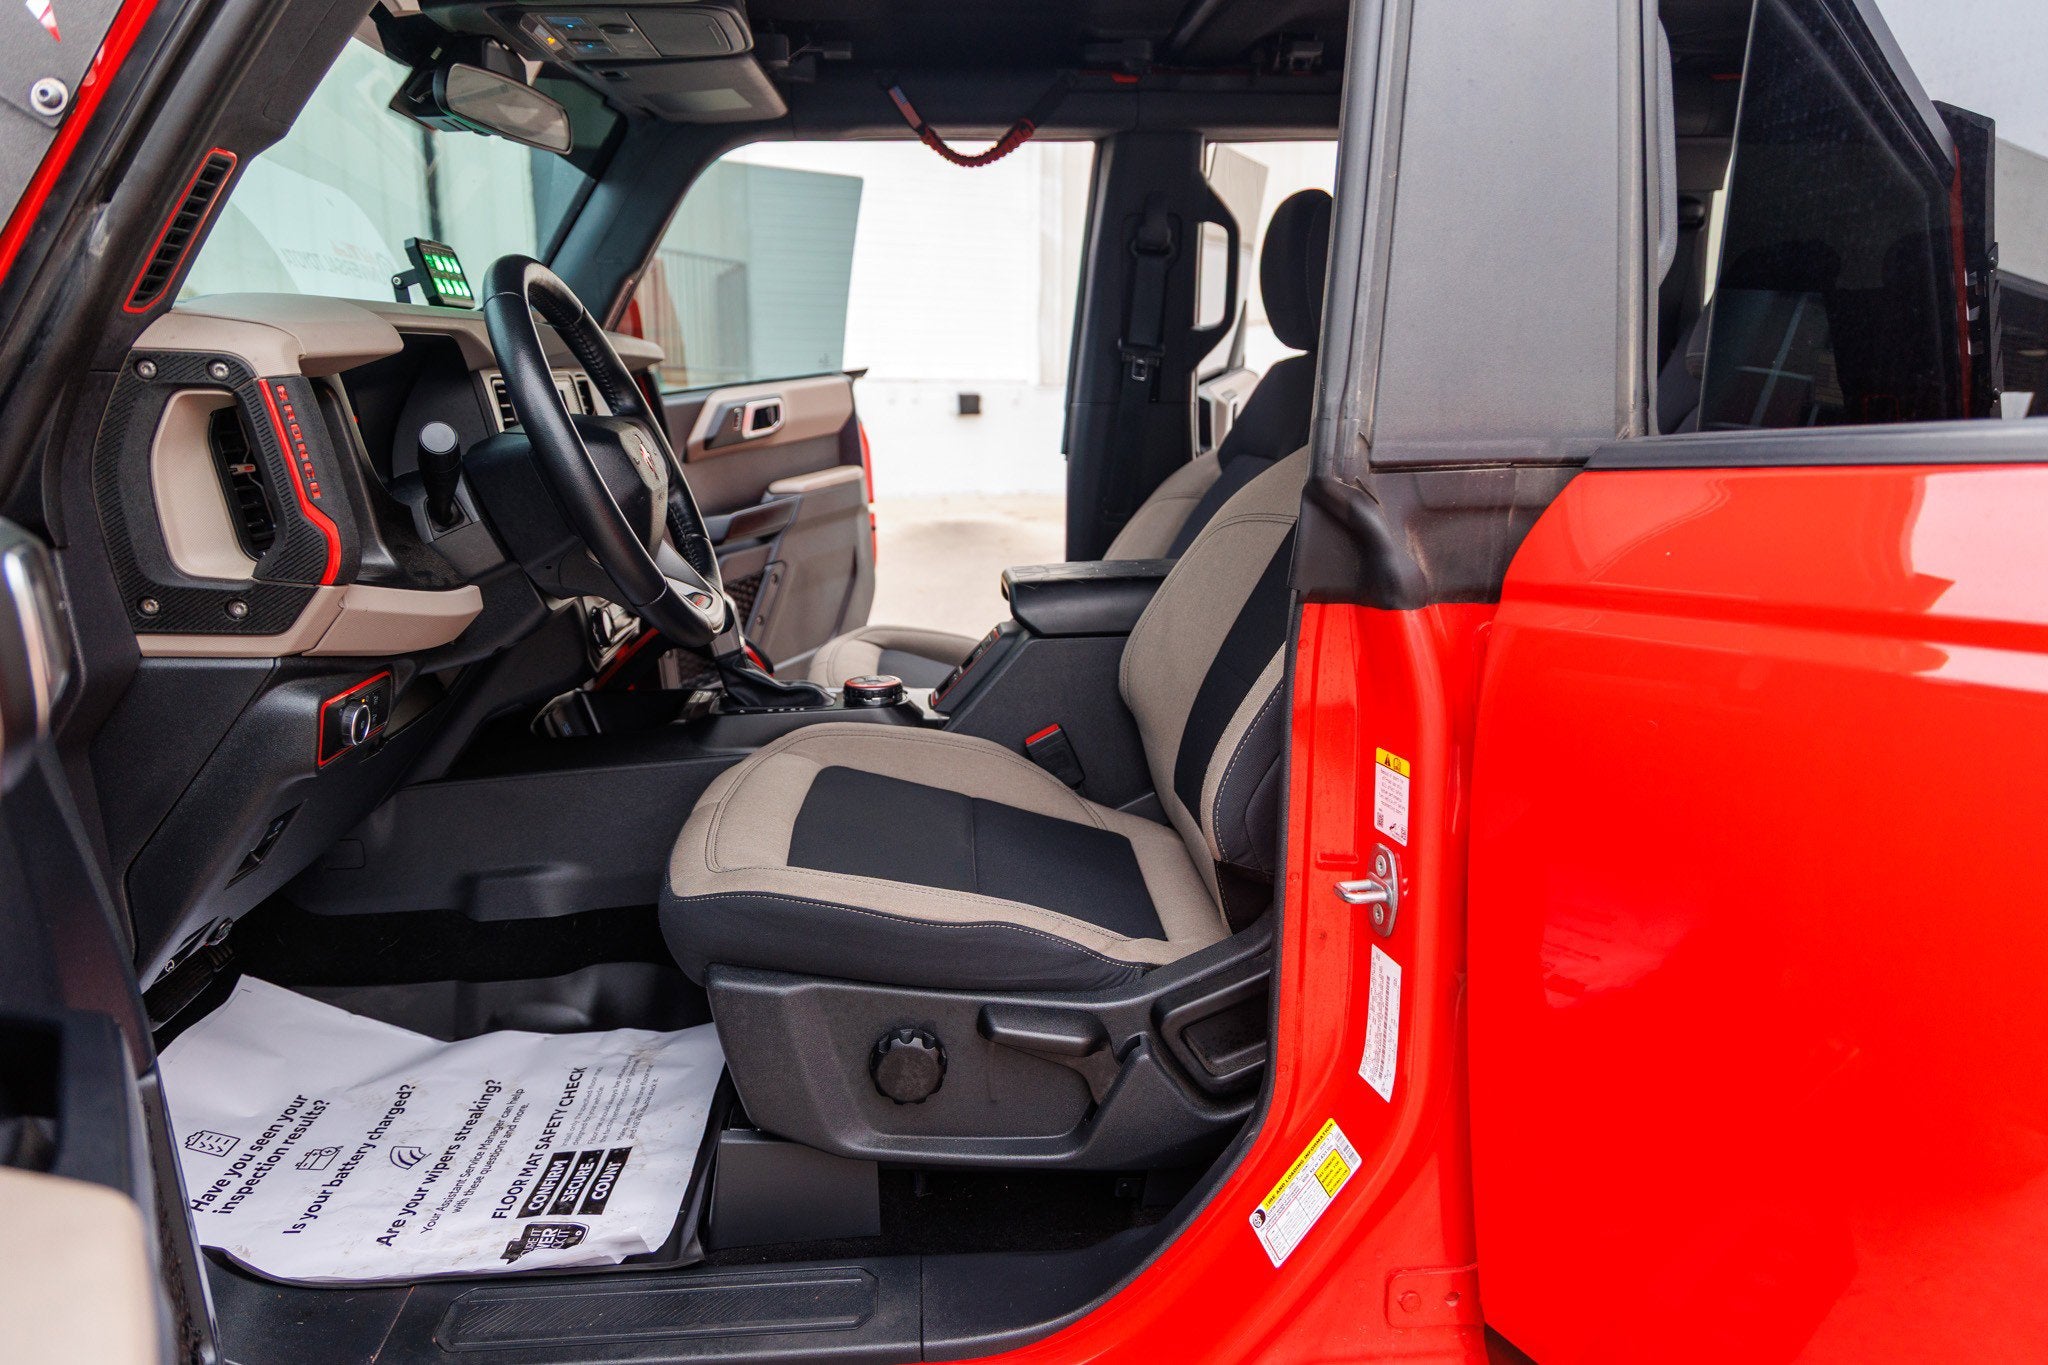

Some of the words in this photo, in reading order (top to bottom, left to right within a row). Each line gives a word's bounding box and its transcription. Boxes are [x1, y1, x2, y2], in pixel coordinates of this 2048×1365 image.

[275, 384, 322, 499] BRONCO
[501, 1104, 514, 1119] can
[507, 1088, 525, 1106] help
[191, 1178, 231, 1213] Have
[223, 1153, 256, 1178] you
[249, 1124, 284, 1152] seen
[276, 1094, 309, 1122] your
[478, 1117, 506, 1152] Manager
[491, 1179, 529, 1219] FLOOR
[518, 1152, 544, 1177] MAT
[535, 1109, 568, 1150] SAFETY
[559, 1066, 588, 1107] CHECK
[1303, 1123, 1333, 1160] INFORMATION
[212, 1146, 290, 1214] inspection
[282, 1099, 331, 1145] results?
[282, 1222, 307, 1235] Is
[299, 1190, 333, 1220] your
[322, 1142, 377, 1187] battery
[366, 1084, 416, 1140] charged?
[376, 1219, 406, 1247] Are
[398, 1187, 430, 1216] your
[422, 1144, 461, 1186] wipers
[454, 1079, 502, 1142] streaking?
[452, 1200, 468, 1214] with
[463, 1176, 485, 1198] these
[480, 1139, 508, 1176] questions
[503, 1124, 517, 1139] and
[512, 1103, 530, 1124] more.
[459, 1151, 485, 1178] Service
[436, 1177, 468, 1212] Assistant
[527, 1159, 569, 1211] CONFIRM
[560, 1162, 595, 1202] SECURE
[591, 1161, 623, 1200] COUNT
[420, 1212, 442, 1234] Your
